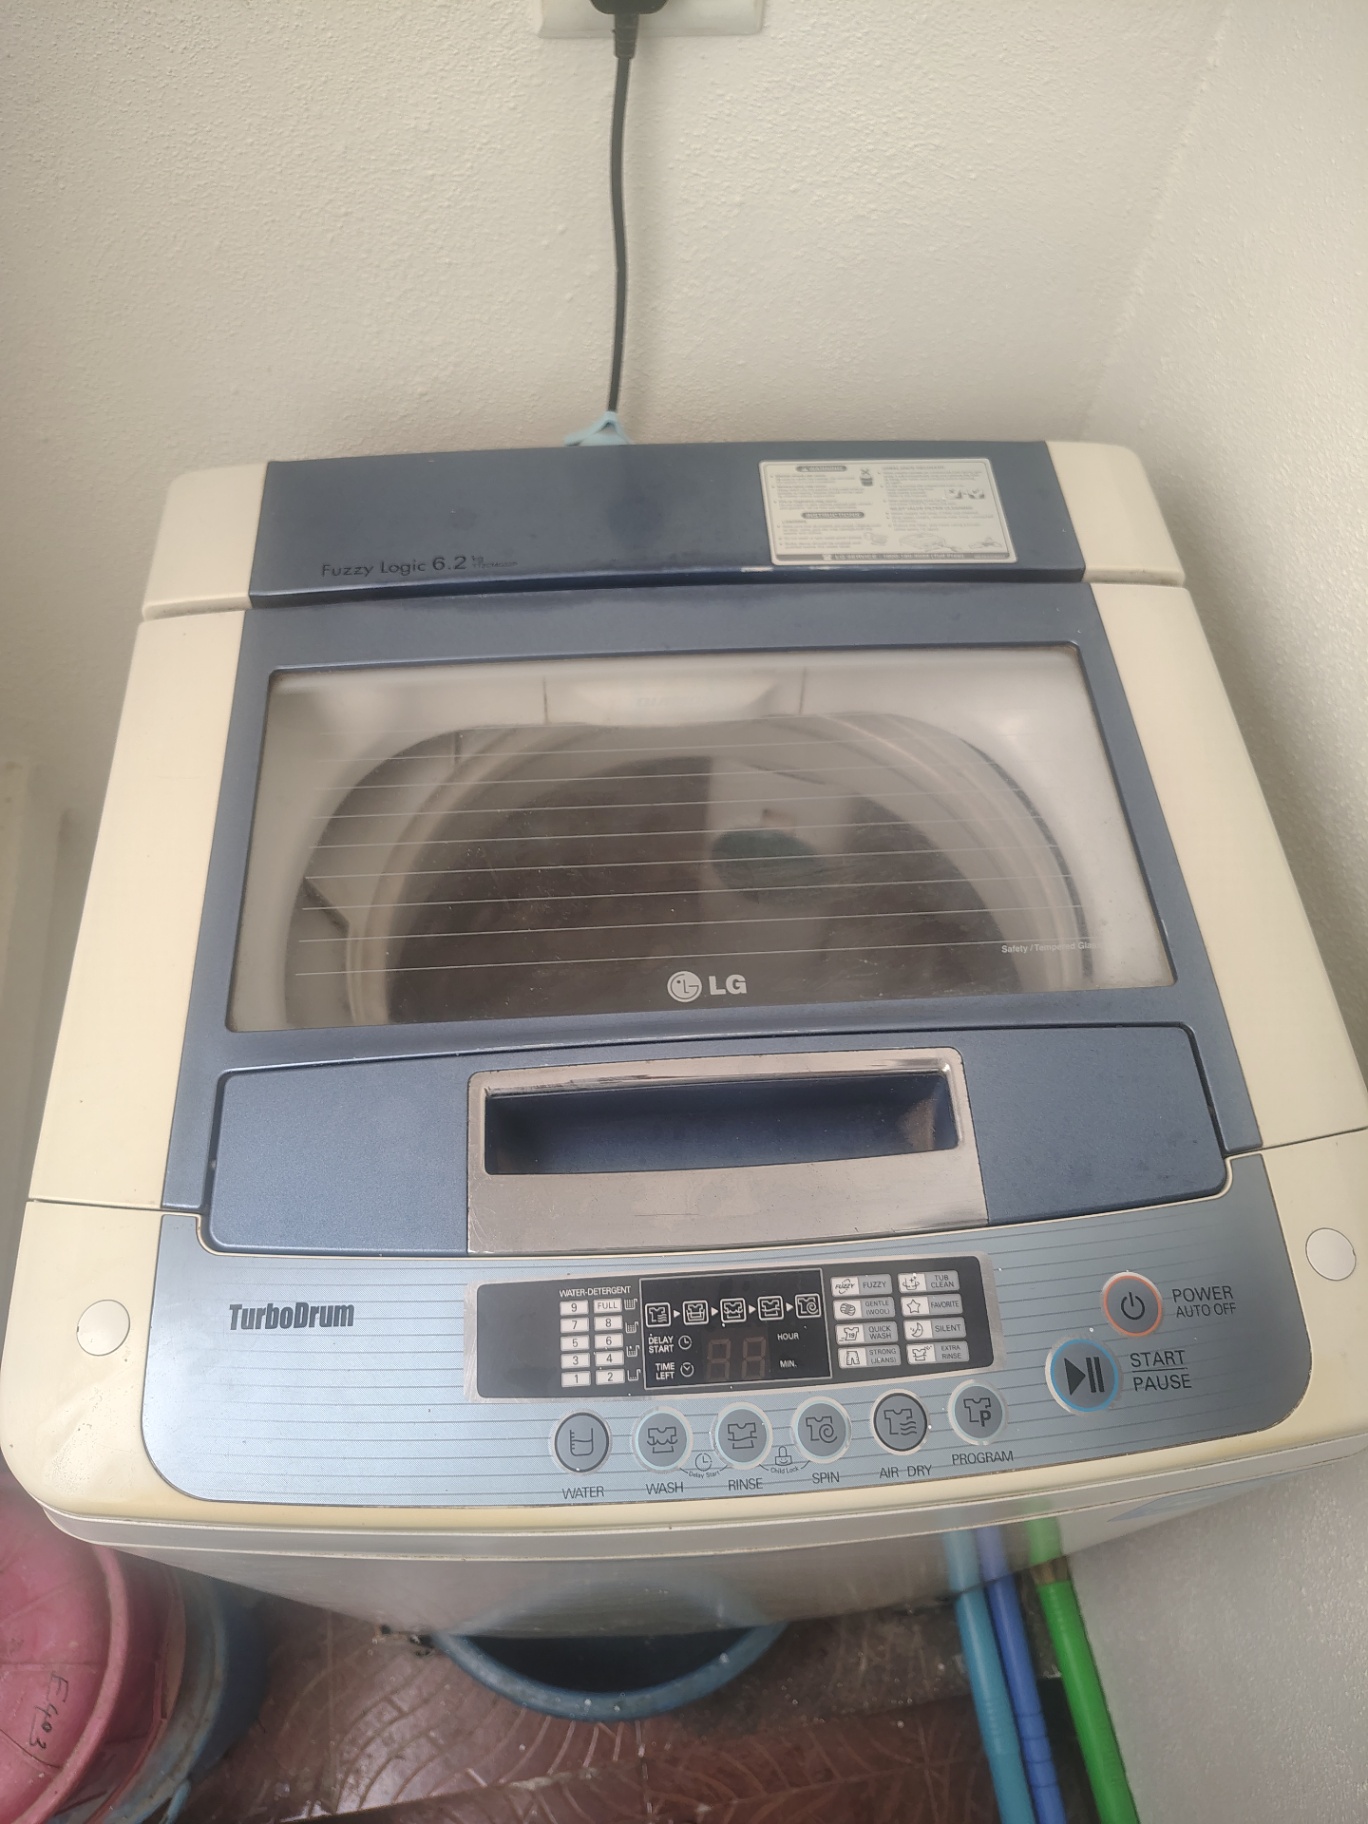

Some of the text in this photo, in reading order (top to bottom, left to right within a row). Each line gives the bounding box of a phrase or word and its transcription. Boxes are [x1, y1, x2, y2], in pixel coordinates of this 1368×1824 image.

[321, 563, 374, 578] Fuzzy
[380, 559, 428, 576] Logic
[432, 555, 467, 571] 6.2
[1001, 944, 1028, 954] Safety
[708, 974, 747, 995] LG
[862, 1281, 886, 1289] FUZZY
[559, 1285, 631, 1298] WATER-DETERGENT
[1172, 1285, 1234, 1303] POWER
[571, 1299, 618, 1312] 9 FULL
[930, 1301, 960, 1309] FAVORITE
[1176, 1302, 1237, 1318] AUTO OFF
[229, 1302, 355, 1330] TurboDrum
[571, 1318, 612, 1330] 7 8
[934, 1324, 961, 1332] SILENT
[572, 1336, 612, 1348] 5 6
[648, 1336, 674, 1345] DELAY
[777, 1332, 800, 1341] HOUR
[648, 1344, 675, 1354] START
[869, 1348, 896, 1356] STRONG
[572, 1354, 613, 1365] 3 4
[779, 1360, 797, 1368] MIN.
[1130, 1350, 1186, 1368] START
[655, 1362, 675, 1371] TIME
[607, 1372, 614, 1382] 2
[655, 1371, 675, 1380] LEFT
[1133, 1374, 1192, 1391] PAUSE
[952, 1450, 1014, 1465] PROGRAM
[688, 1470, 720, 1479] Delay Start
[786, 1466, 799, 1474] Lock
[879, 1465, 932, 1479] AIR DRY
[812, 1472, 840, 1484] SPIN
[646, 1482, 684, 1495] WASH
[728, 1478, 764, 1491] RINSE
[562, 1486, 605, 1499] WATER
